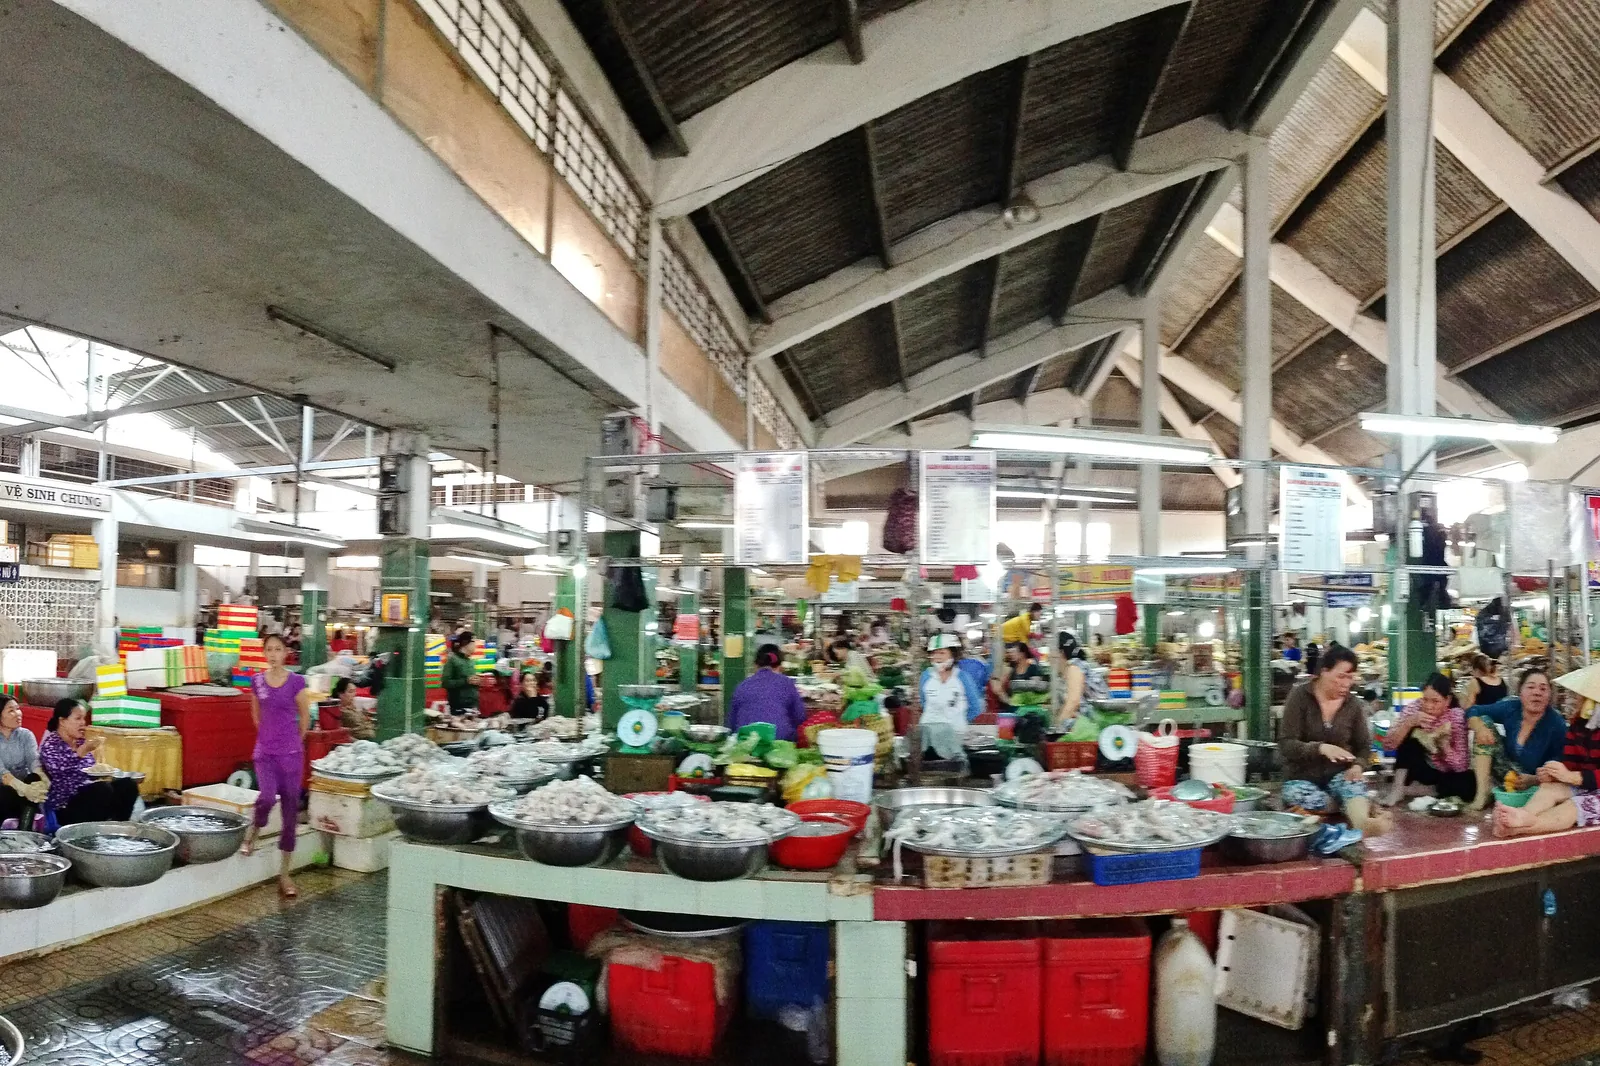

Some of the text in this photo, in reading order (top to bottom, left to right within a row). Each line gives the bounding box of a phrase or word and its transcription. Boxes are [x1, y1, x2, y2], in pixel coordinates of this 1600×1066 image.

[5, 485, 102, 507] VỆ SINH CHUNG
